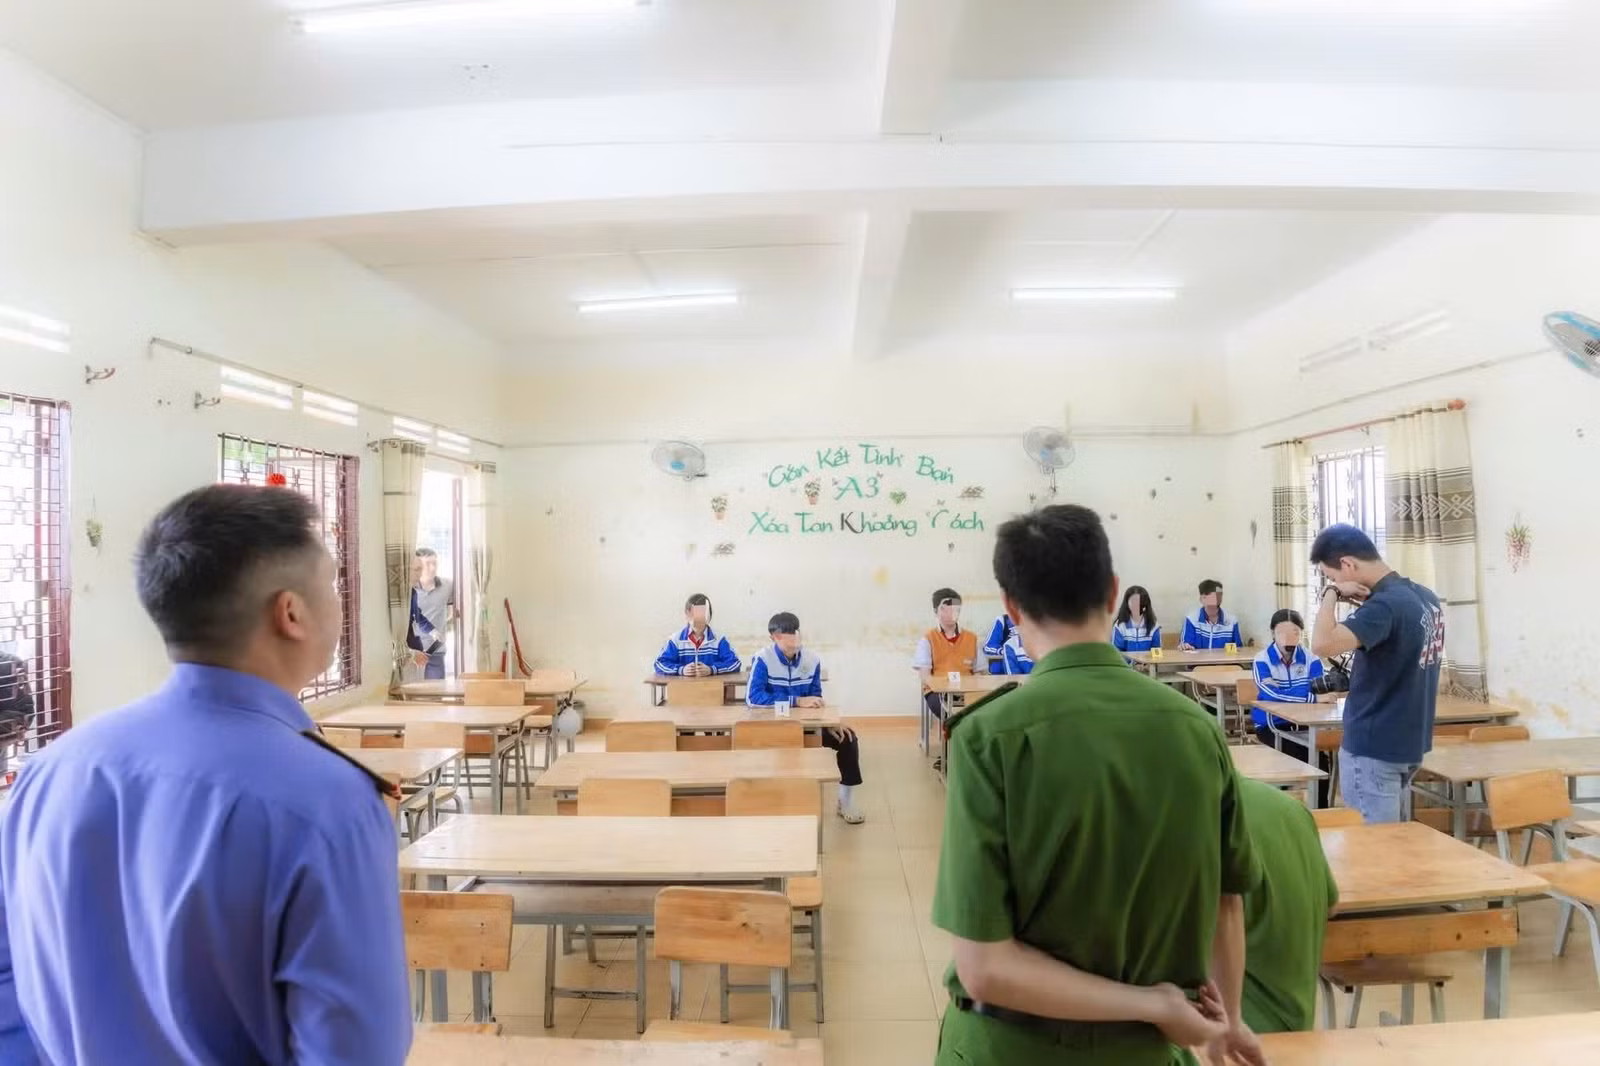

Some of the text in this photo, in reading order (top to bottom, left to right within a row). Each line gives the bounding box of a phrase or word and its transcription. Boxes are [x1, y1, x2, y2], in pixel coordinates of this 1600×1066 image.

[834, 476, 879, 500] A3
[748, 511, 790, 534] Xóa
[794, 512, 833, 533] Tan
[840, 511, 918, 537] Khoảng
